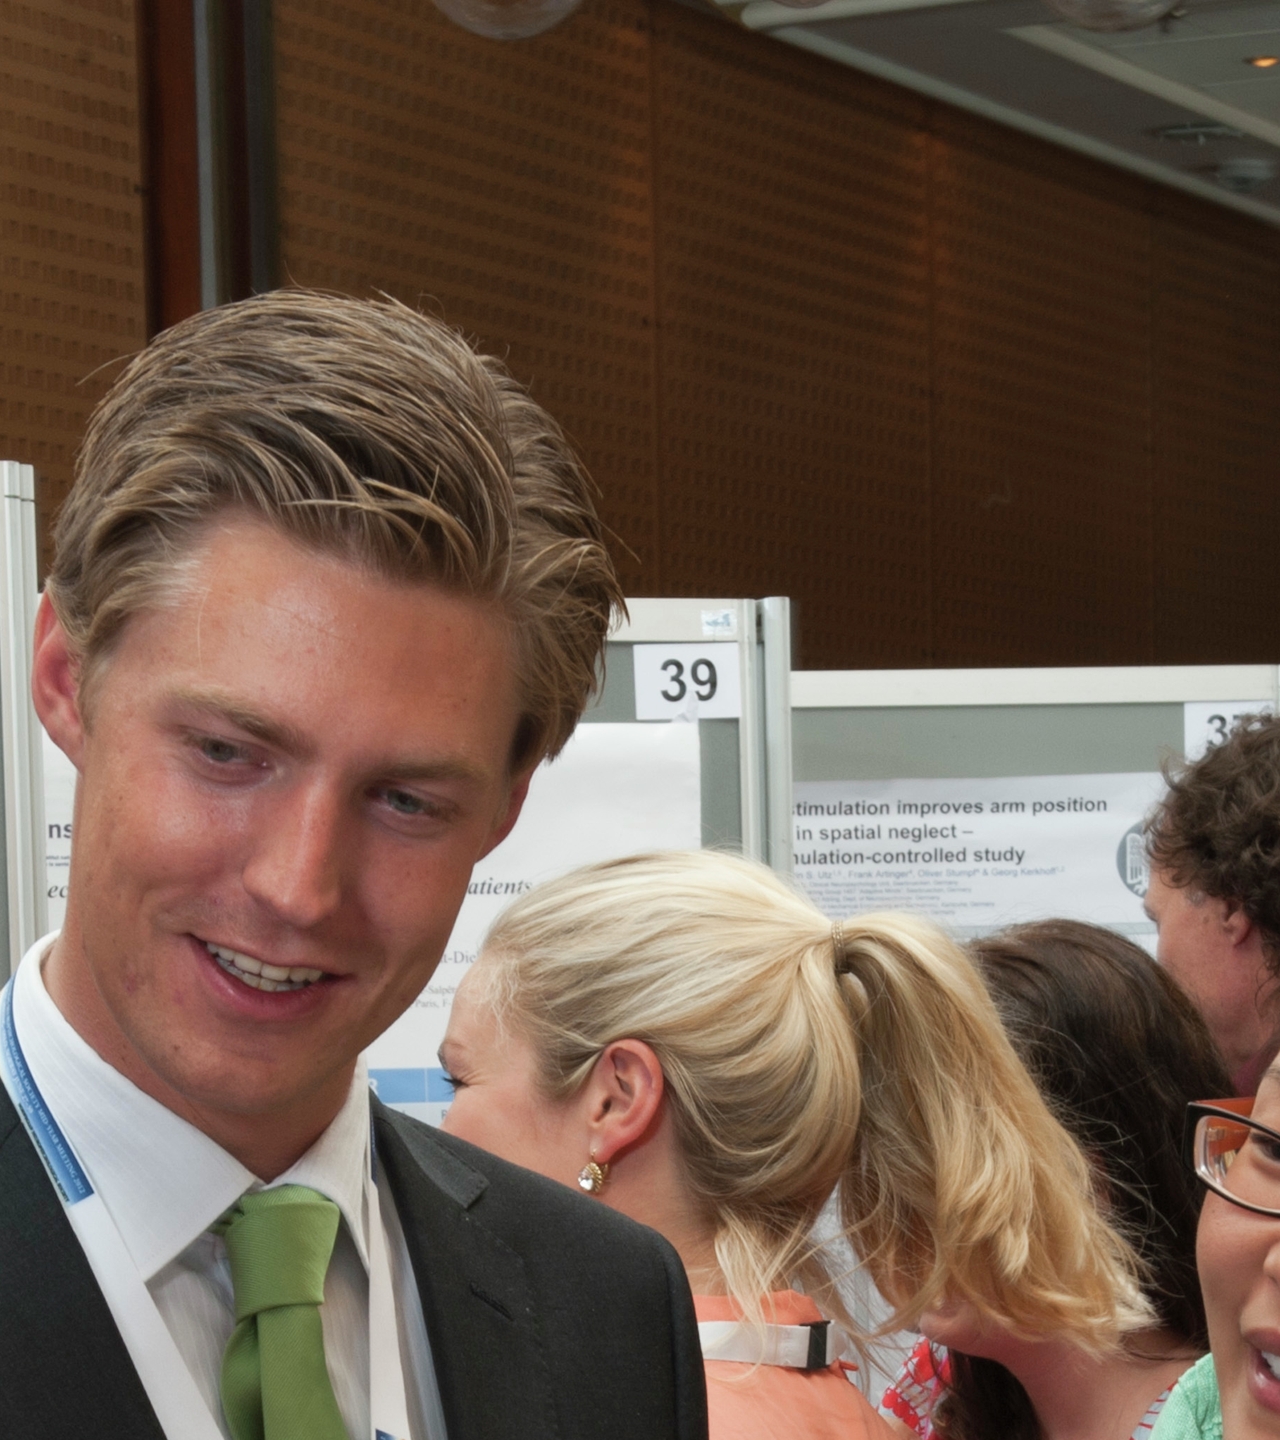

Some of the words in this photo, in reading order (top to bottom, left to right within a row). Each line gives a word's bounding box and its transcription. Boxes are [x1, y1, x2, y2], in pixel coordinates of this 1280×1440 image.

[660, 658, 717, 703] 39
[897, 799, 984, 818] improves
[990, 801, 1025, 814] arm
[1031, 797, 1108, 816] position
[796, 825, 813, 840] in
[819, 825, 881, 844] spatial
[888, 823, 957, 843] neglect
[973, 846, 1025, 866] study
[468, 876, 533, 896] atients
